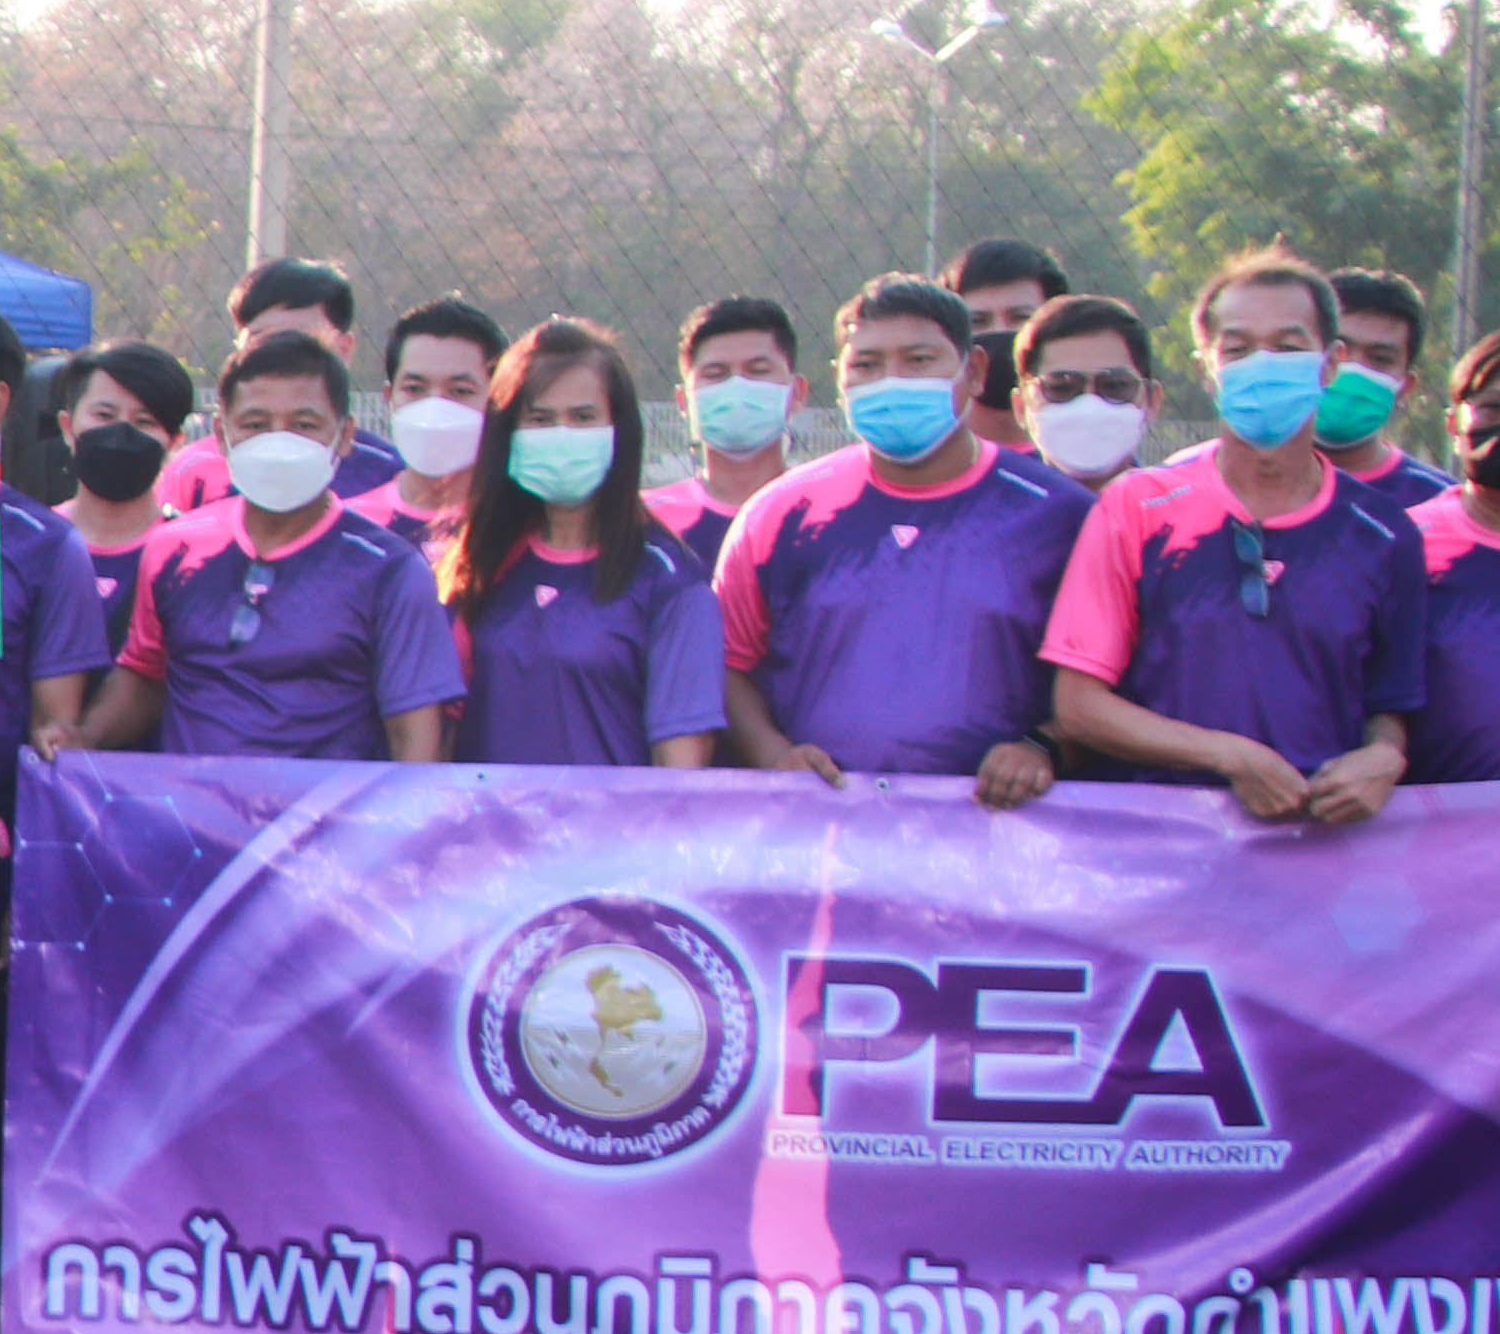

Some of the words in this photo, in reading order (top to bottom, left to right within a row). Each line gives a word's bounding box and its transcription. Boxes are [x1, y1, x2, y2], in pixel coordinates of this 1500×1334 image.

[781, 955, 1265, 1127] PEA
[771, 1132, 934, 1161] PROVINCIAL
[944, 1137, 1117, 1165] ELECTRICITY
[1130, 1141, 1286, 1167] AUTHORITY
